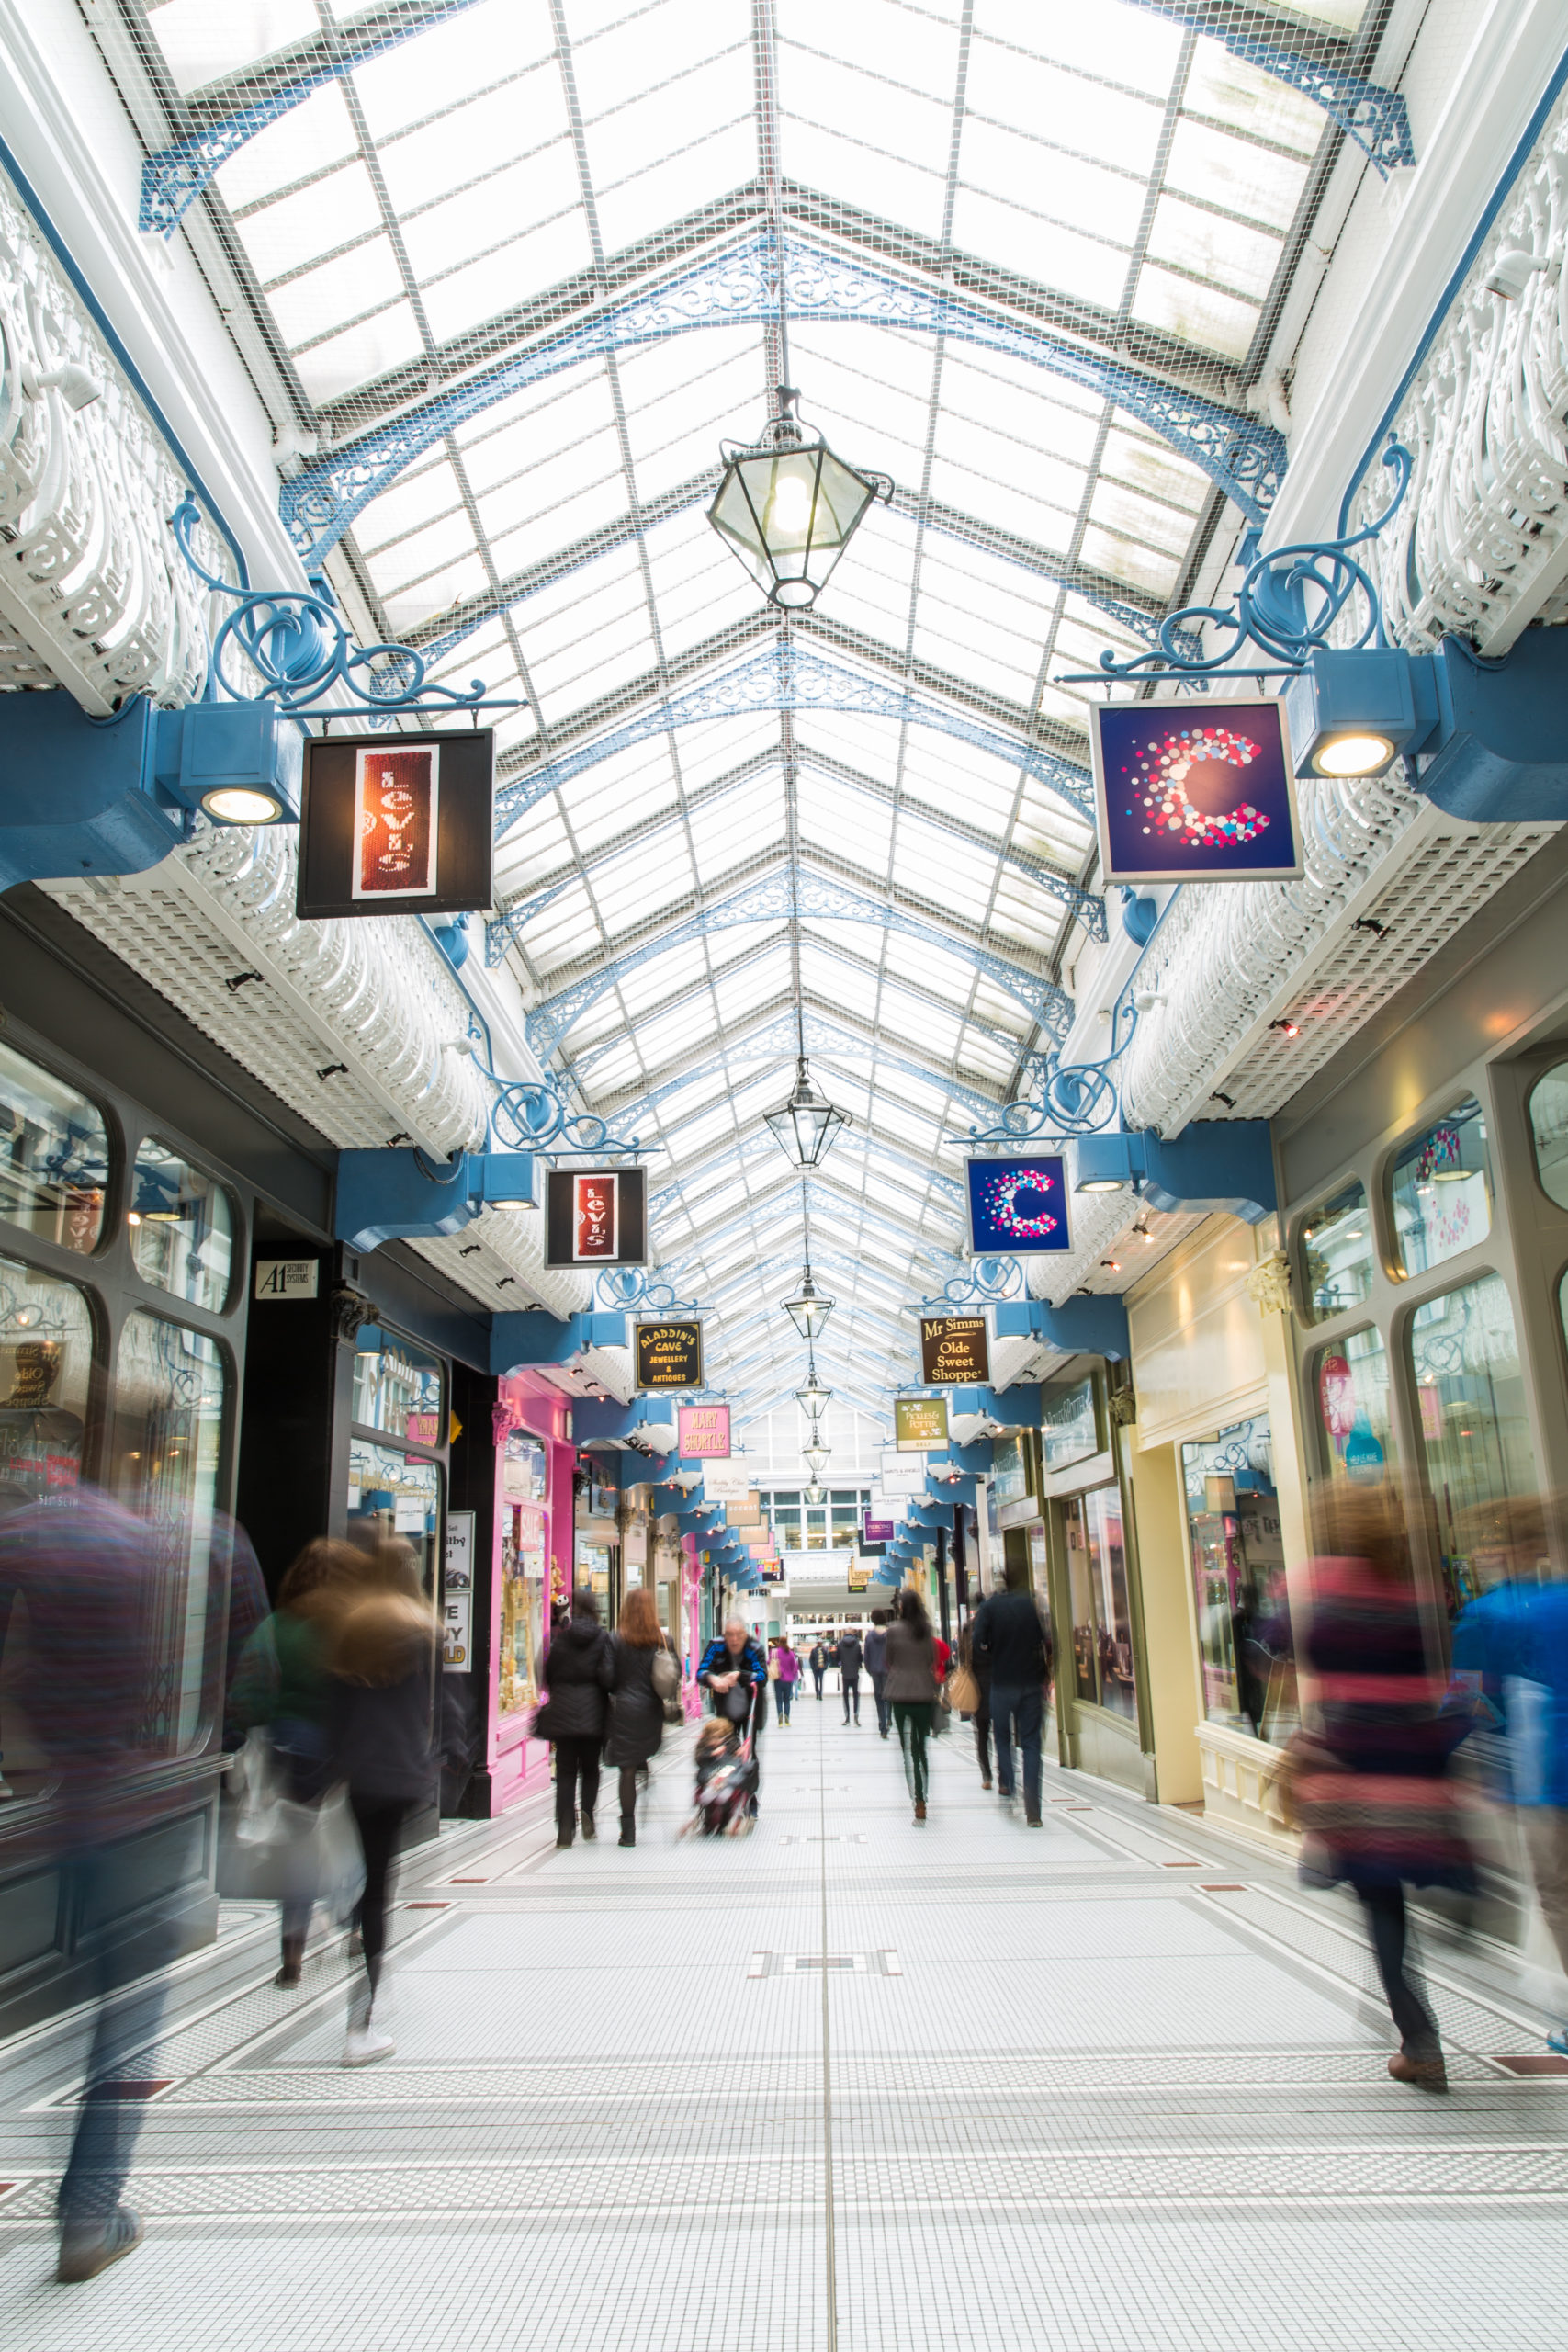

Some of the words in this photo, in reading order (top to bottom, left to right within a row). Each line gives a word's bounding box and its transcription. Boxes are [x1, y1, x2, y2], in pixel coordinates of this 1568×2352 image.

[286, 1263, 310, 1273] SECURITY
[259, 1264, 287, 1293] A1
[286, 1273, 310, 1284] SYSTEMS
[924, 1320, 943, 1341] Mr
[945, 1318, 985, 1332] Simms
[640, 1328, 696, 1349] ALADDIN'S
[655, 1341, 682, 1352] CAVE
[939, 1341, 970, 1354] Olde
[649, 1354, 688, 1364] JEWELLERY
[937, 1355, 974, 1367] Sweet
[652, 1374, 686, 1383] ANTIQUES
[692, 1410, 717, 1429] MARY
[684, 1432, 726, 1452] SHORTLE
[446, 1605, 458, 1620] E
